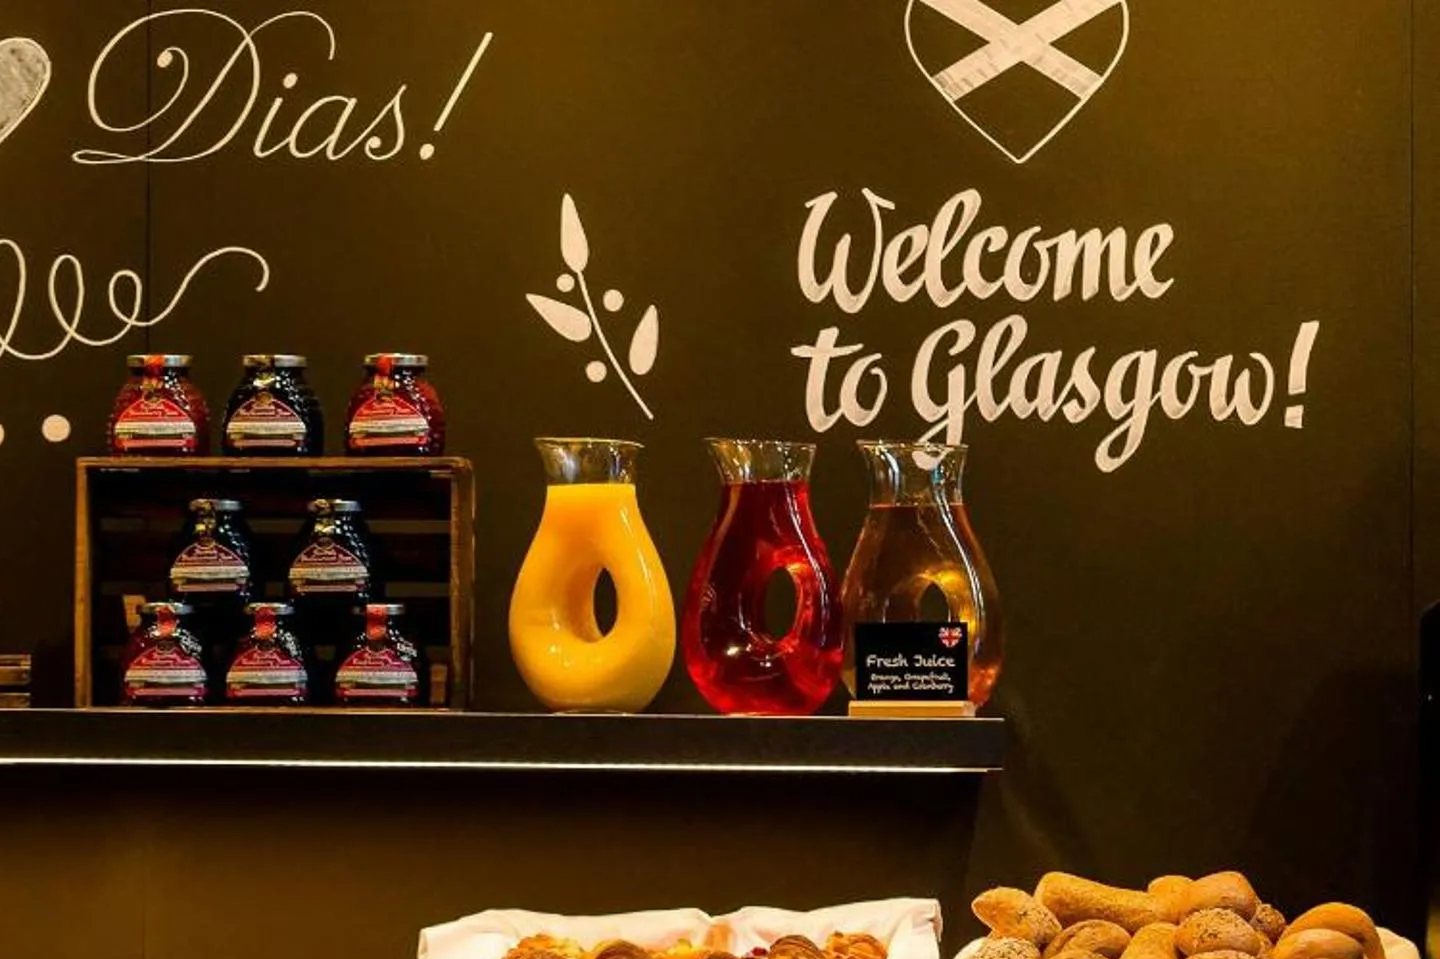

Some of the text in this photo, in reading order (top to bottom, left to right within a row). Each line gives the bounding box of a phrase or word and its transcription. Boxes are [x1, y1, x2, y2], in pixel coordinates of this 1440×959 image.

[72, 9, 494, 165] Dias!
[797, 188, 1175, 314] Welcome
[790, 314, 1320, 473] to Glasgow!
[865, 652, 956, 668] Fresh Juice
